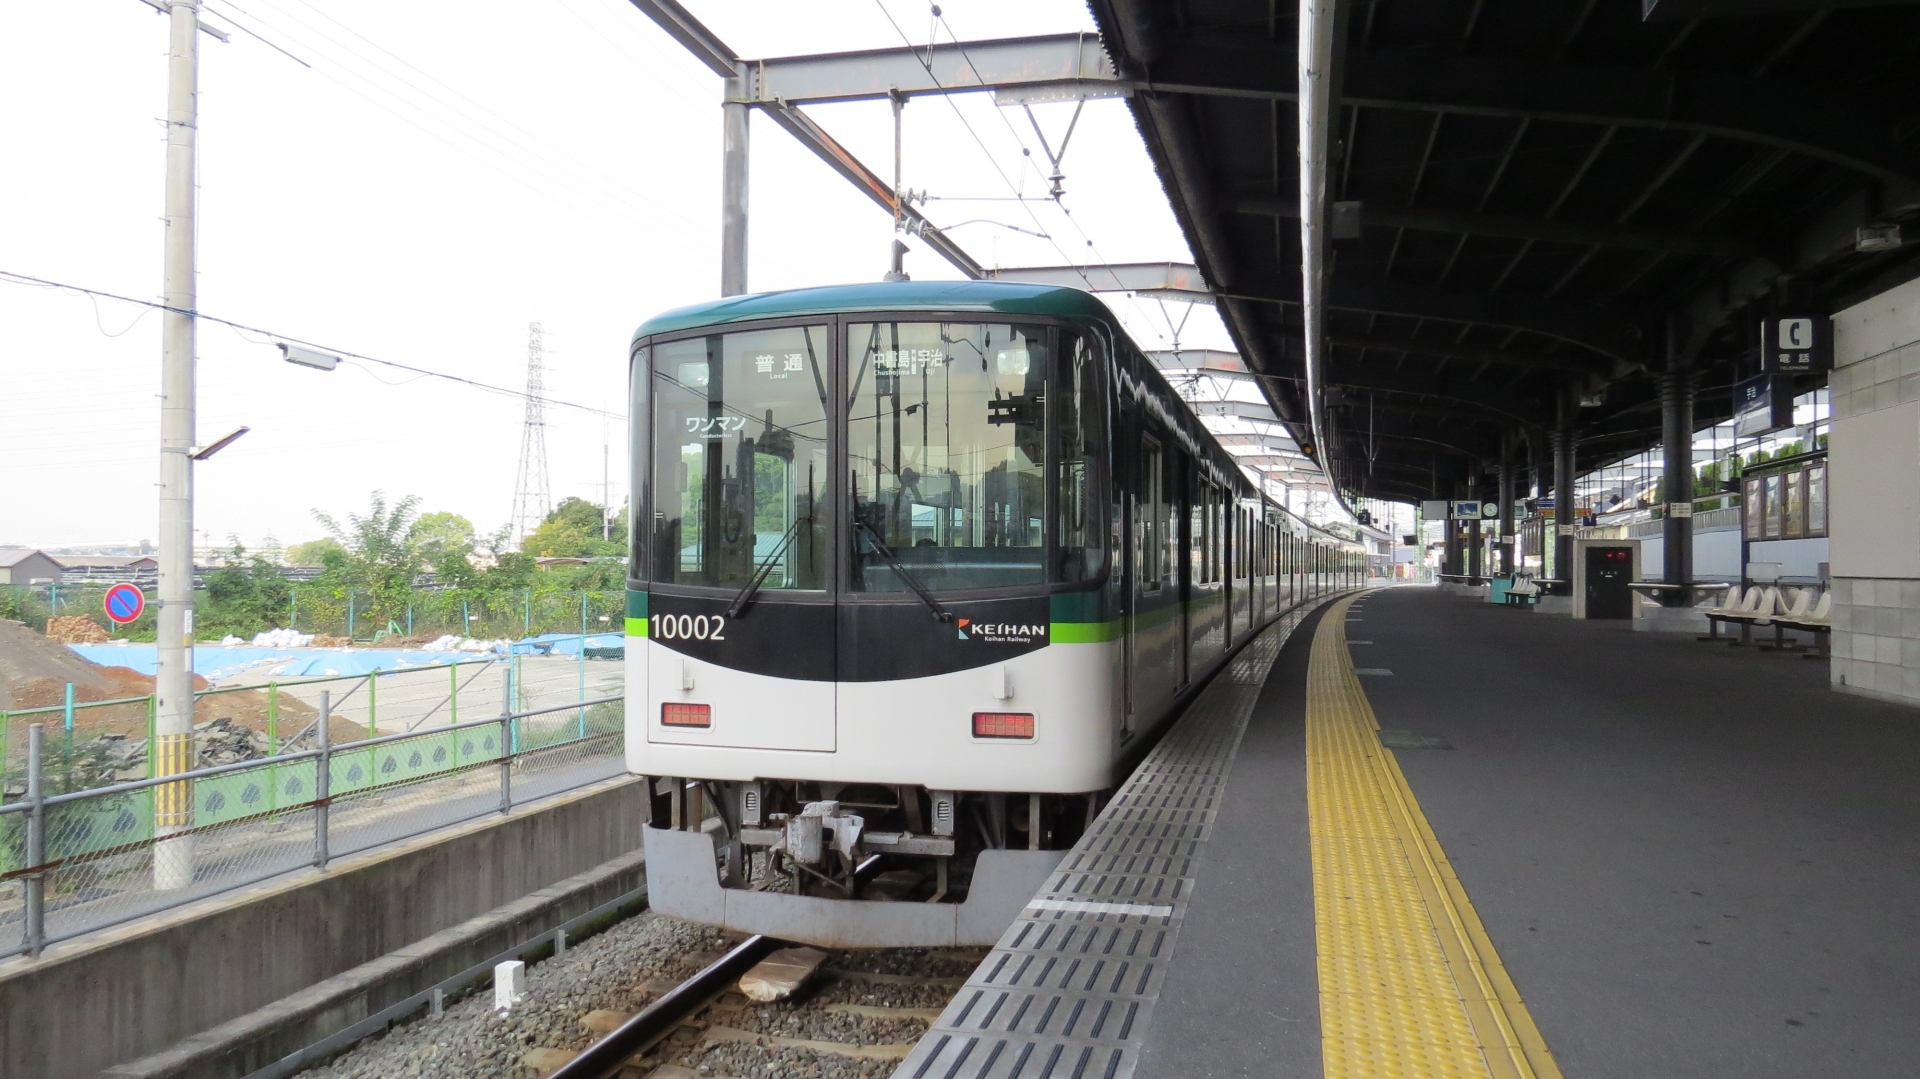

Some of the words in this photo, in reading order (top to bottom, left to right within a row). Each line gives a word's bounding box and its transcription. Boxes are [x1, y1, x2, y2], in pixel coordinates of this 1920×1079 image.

[755, 353, 803, 373] 普通
[873, 350, 910, 369] 中書島
[918, 348, 943, 367] 宇治
[1779, 353, 1810, 363] 電話
[925, 368, 936, 376] Uji
[686, 416, 746, 433] ワンマン
[1361, 514, 1367, 522] 2
[651, 613, 725, 640] 10002
[971, 622, 1045, 636] KEIHAN
[1006, 636, 1031, 644] Railway
